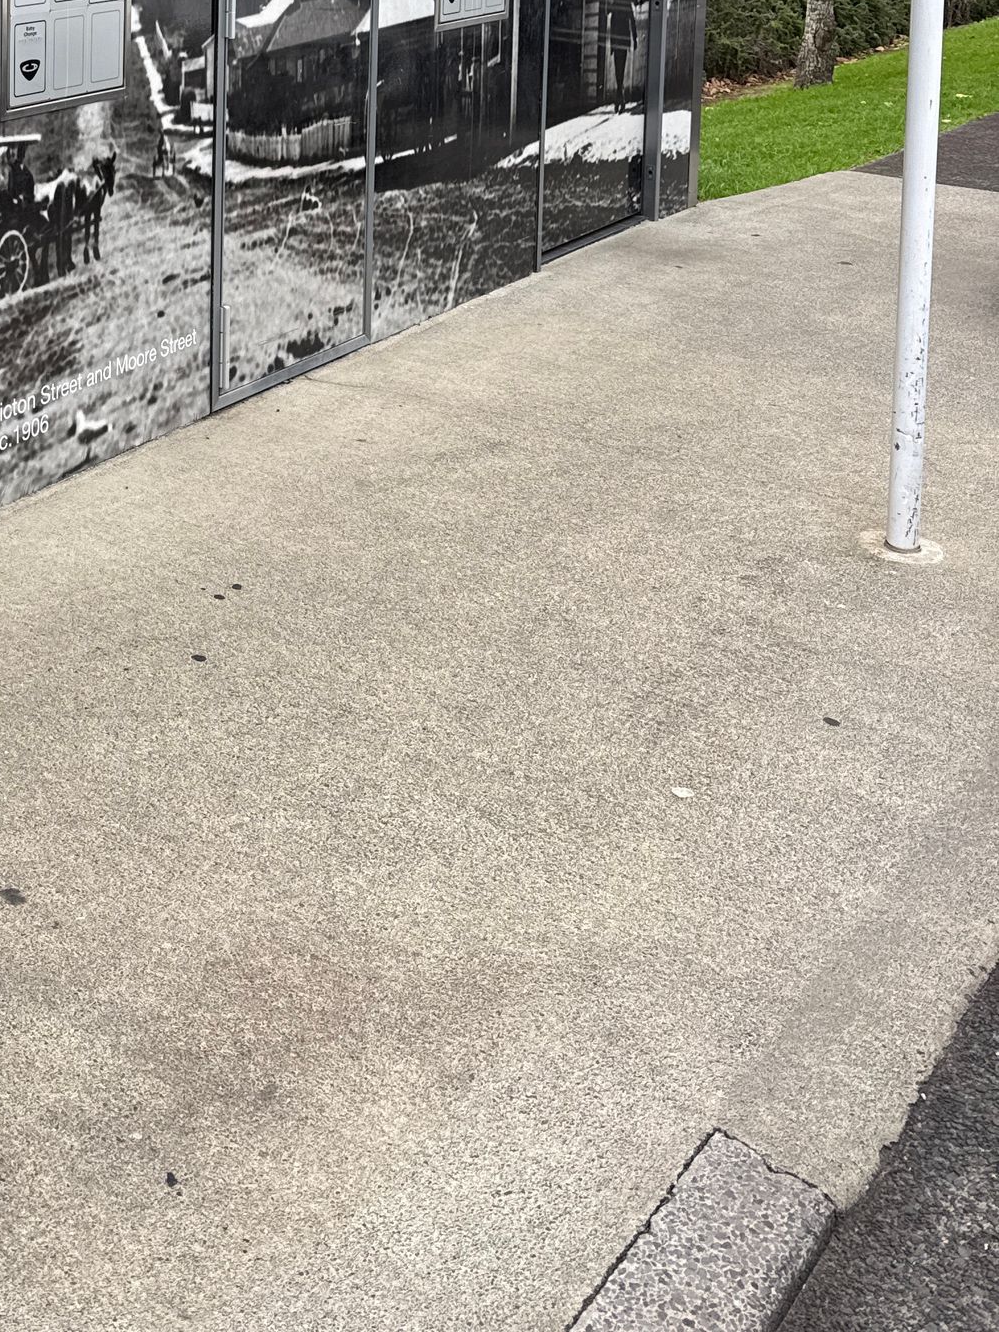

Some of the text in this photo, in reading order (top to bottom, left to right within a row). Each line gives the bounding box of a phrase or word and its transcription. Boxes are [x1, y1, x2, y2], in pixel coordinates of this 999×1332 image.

[40, 373, 82, 405] Street
[86, 362, 111, 388] and
[116, 348, 157, 375] Moore
[161, 328, 197, 358] Street
[0, 414, 49, 451] c.1906
